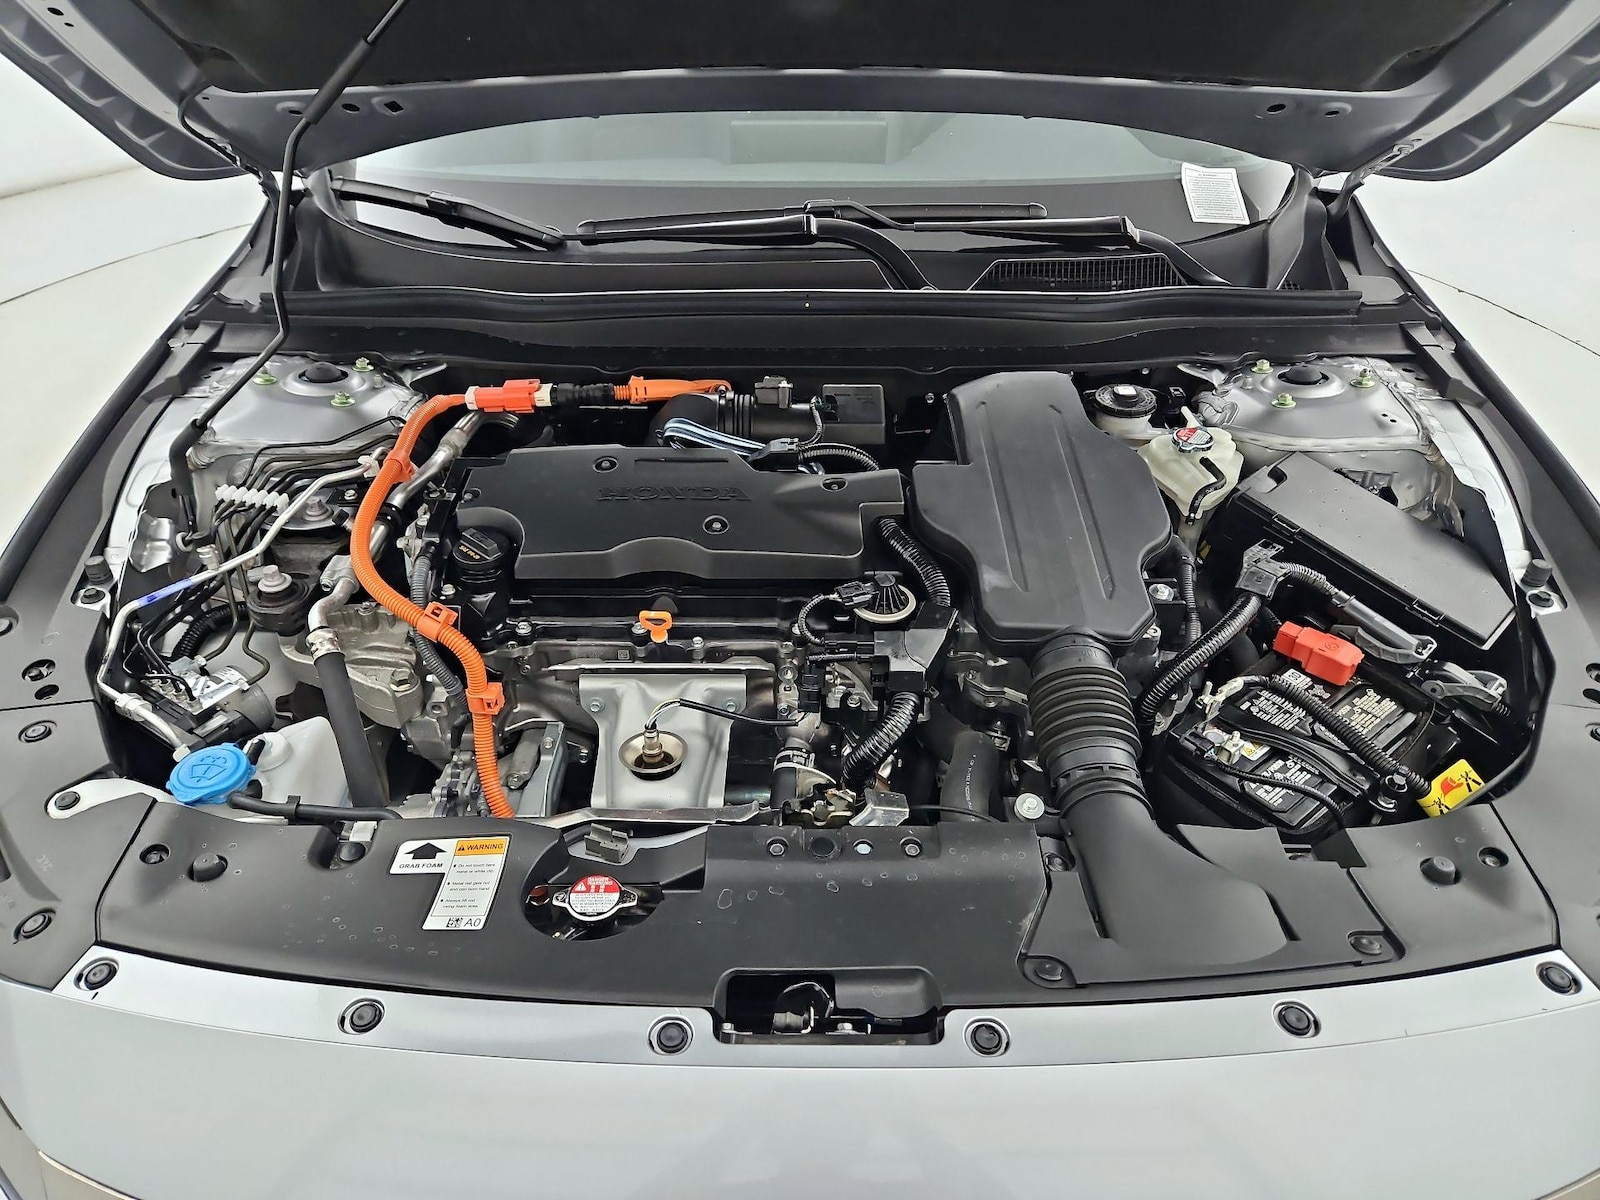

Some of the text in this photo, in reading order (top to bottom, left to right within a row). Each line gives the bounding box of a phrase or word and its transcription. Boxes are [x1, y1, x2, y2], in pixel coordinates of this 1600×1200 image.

[598, 486, 751, 502] HONDA
[467, 843, 504, 851] WARNING
[463, 917, 482, 928] A0
